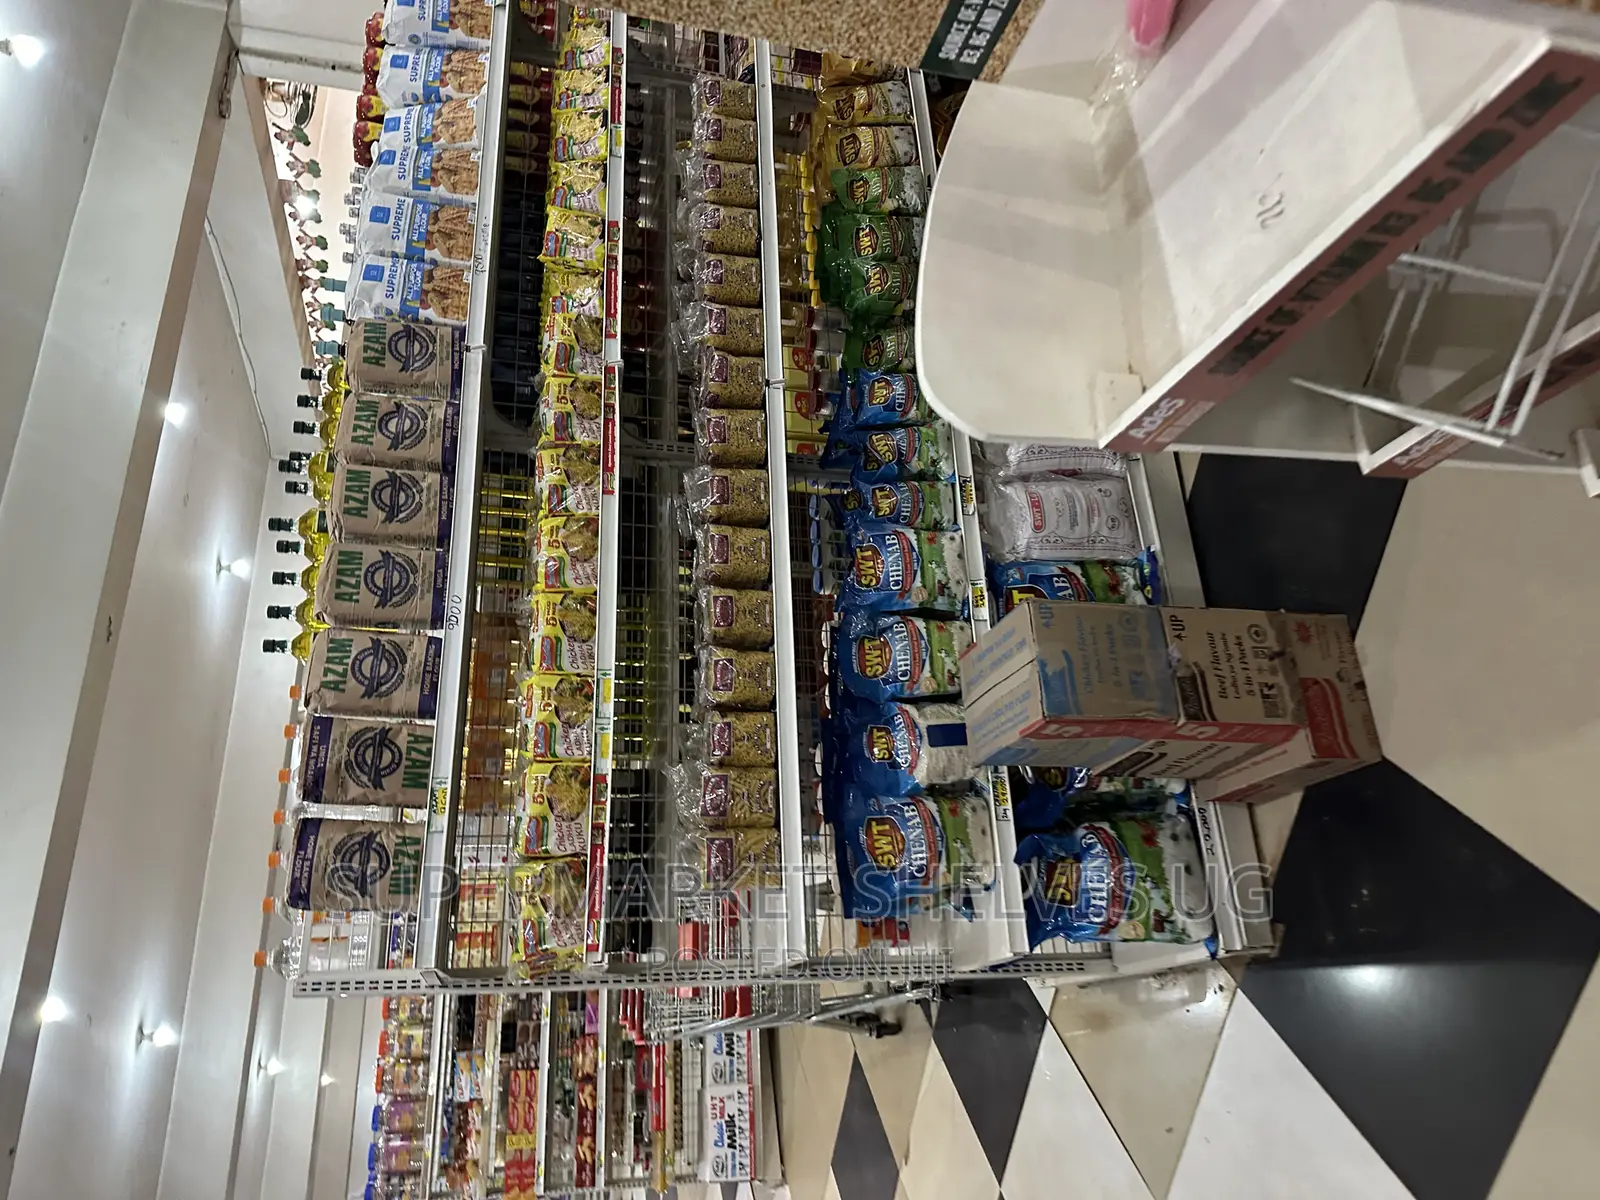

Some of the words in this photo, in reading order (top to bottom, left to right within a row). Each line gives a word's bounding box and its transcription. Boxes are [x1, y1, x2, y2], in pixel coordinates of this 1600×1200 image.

[938, 21, 972, 60] SOURCE
[404, 108, 415, 142] SUPREME
[398, 146, 410, 180] SUPREME
[844, 137, 856, 163] SWT
[854, 180, 864, 203] SWT
[391, 198, 406, 240] SUPREME
[859, 230, 872, 255] SWT
[385, 257, 400, 299] SUPREME
[869, 267, 881, 294] SWT
[363, 322, 387, 367] AZAM
[869, 341, 880, 365] SWT
[557, 396, 568, 404] 5
[874, 382, 886, 404] SWT
[351, 400, 380, 446] AZAM
[872, 433, 893, 462] SWT
[343, 469, 371, 518] AZAM
[874, 488, 891, 515] SWT
[1032, 508, 1041, 526] SWT
[548, 539, 560, 548] 5
[334, 550, 363, 603] AZAM
[855, 547, 876, 586] SWT
[885, 534, 903, 590] CHENAB
[1039, 603, 1054, 618] UP
[1170, 614, 1186, 631] UP
[320, 638, 354, 693] AZAM
[566, 636, 580, 669] Chicken
[578, 644, 588, 669] LADHA
[586, 644, 595, 670] KUKU
[864, 638, 884, 676] SWT
[892, 623, 911, 680] CHENAB
[1206, 632, 1222, 671] Flavour
[1234, 635, 1248, 664] Packs
[1214, 673, 1228, 698] Beef
[560, 722, 574, 756] Chicken
[572, 729, 584, 756] LADHA
[872, 728, 890, 758] SWT
[893, 714, 910, 768] CHENAB
[402, 733, 433, 789] AZAM
[553, 814, 567, 852] Chicken
[566, 824, 576, 851] LADHA
[574, 822, 586, 851] KUKU
[872, 821, 896, 868] SWT
[904, 805, 926, 877] CHENAB
[388, 836, 421, 895] AZAM
[1082, 834, 1108, 922] CHENAB
[724, 1032, 734, 1057] Mil
[725, 1112, 737, 1150] Milk
